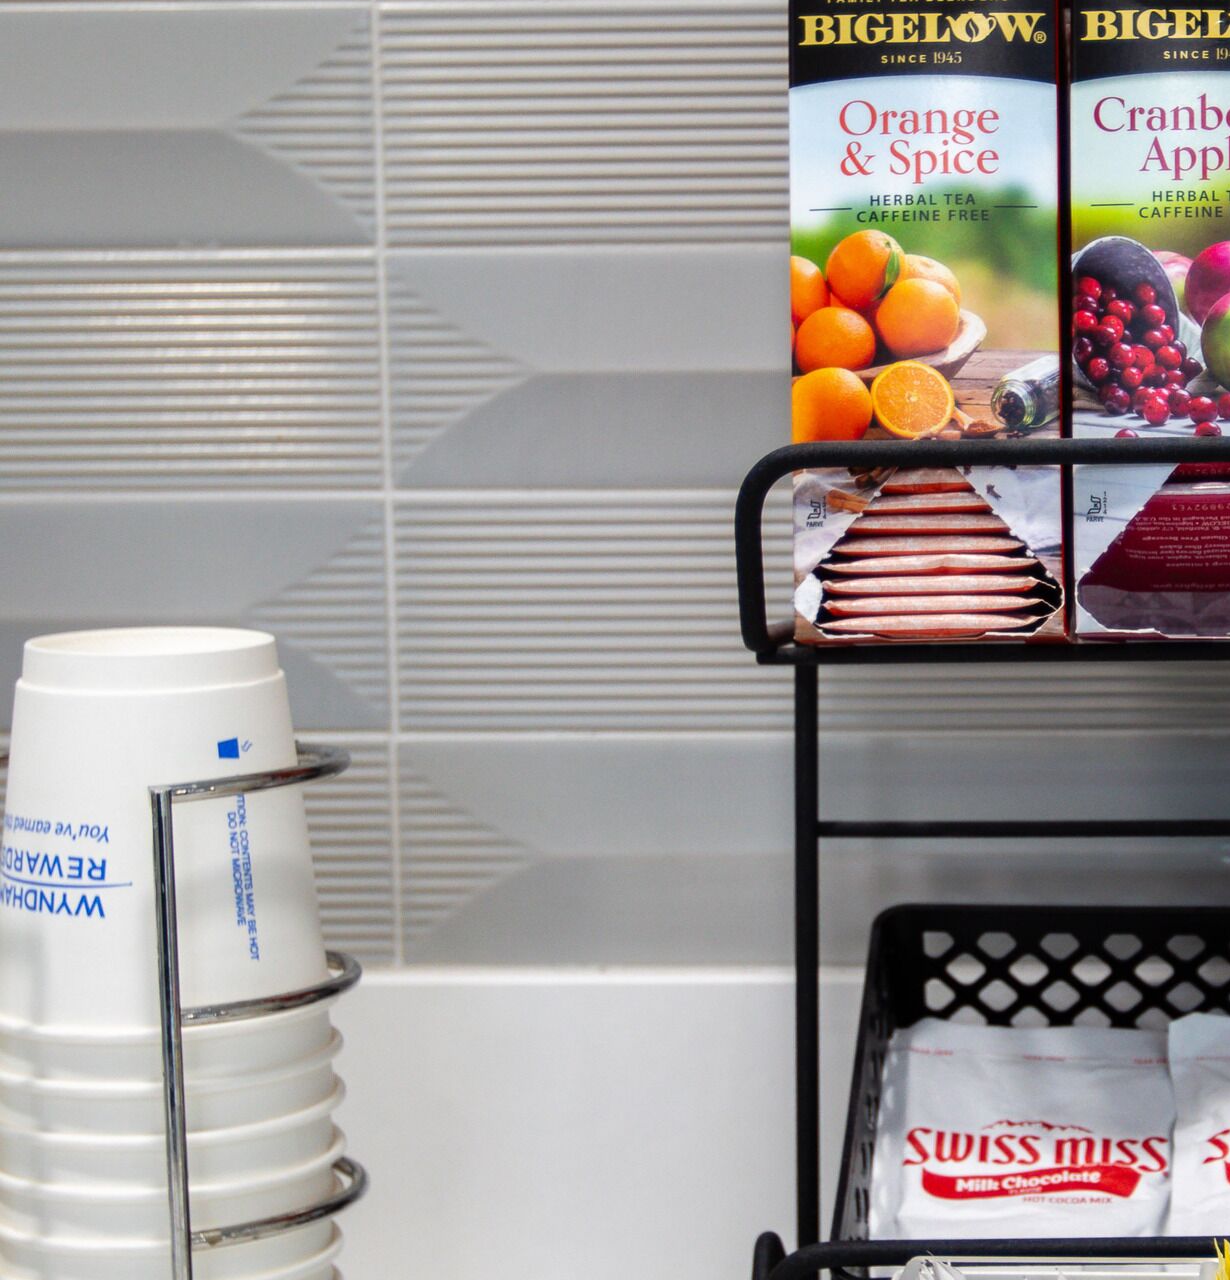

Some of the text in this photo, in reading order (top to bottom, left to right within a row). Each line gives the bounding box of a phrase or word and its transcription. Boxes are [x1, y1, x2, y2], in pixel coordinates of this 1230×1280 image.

[881, 51, 962, 65] SINCE 1945
[1163, 50, 1210, 60] SINCE
[838, 100, 1000, 145] Orange
[840, 140, 1000, 184] & Spice
[869, 192, 976, 207] HERBAL TEA
[1152, 190, 1220, 203] HERBAL
[857, 208, 990, 223] CAFFEINE FREE
[1138, 205, 1224, 219] CAFFEINE
[55, 824, 109, 844] You've
[238, 830, 253, 890] CONTENTS
[227, 812, 246, 927] DO NOT MICROWAVE
[246, 893, 256, 917] MAY
[248, 920, 257, 935] BE
[250, 937, 260, 961] HOT
[956, 1170, 1102, 1193] Milk Chocolate
[1022, 1195, 1113, 1204] HOT COCOA MIX
